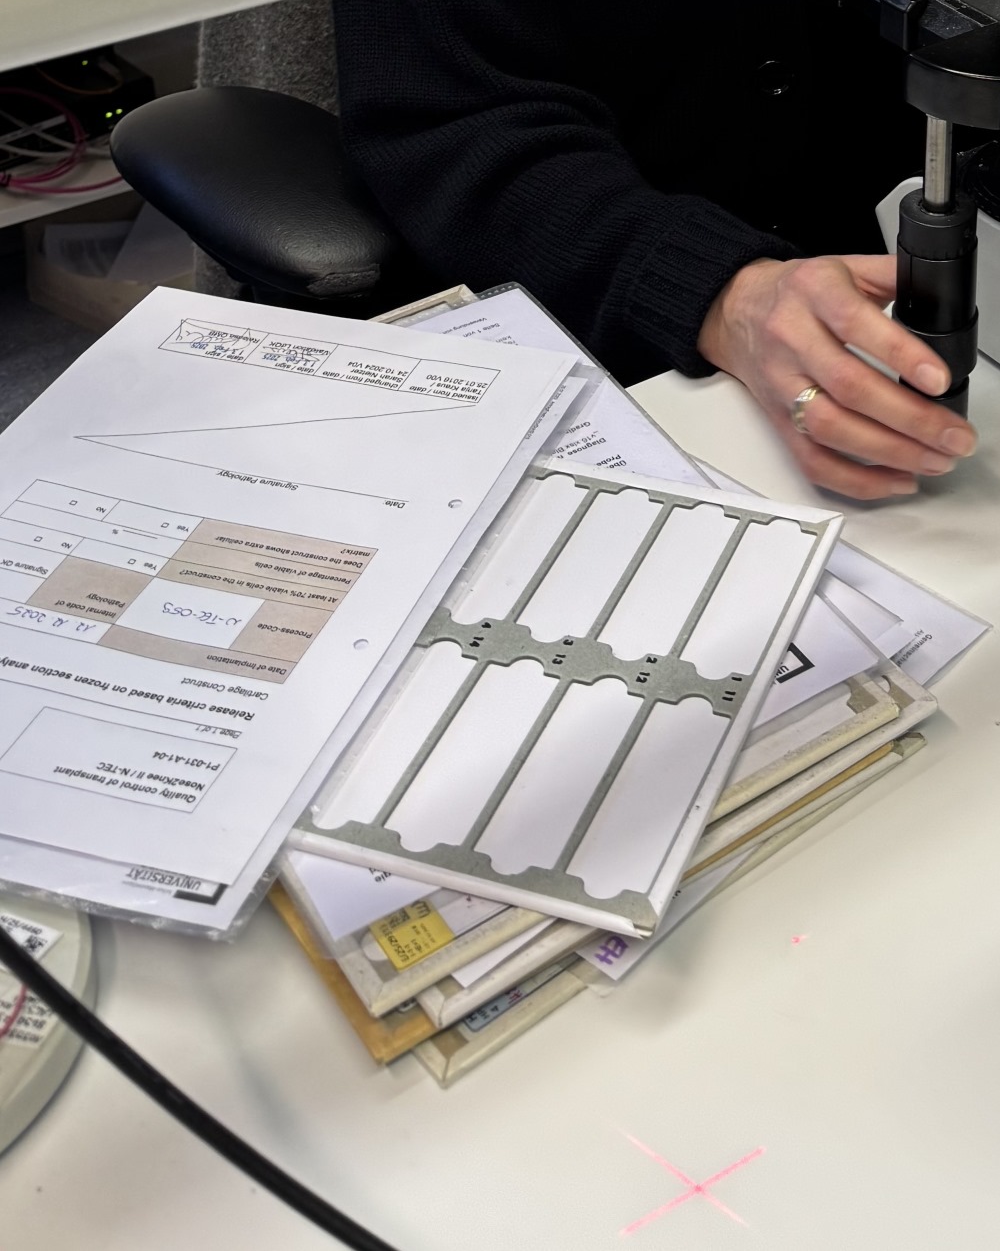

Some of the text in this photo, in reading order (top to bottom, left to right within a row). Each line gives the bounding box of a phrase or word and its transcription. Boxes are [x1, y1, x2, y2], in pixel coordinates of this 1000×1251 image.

[297, 365, 314, 373] date
[345, 375, 363, 383] from
[350, 368, 404, 383] Sarah Nietzer
[364, 377, 399, 390] changed
[436, 383, 482, 395] Tanja Kraus
[433, 389, 451, 398] from
[451, 392, 479, 401] Issued
[567, 437, 607, 456] Diagnose
[260, 477, 299, 491] Signature
[96, 506, 107, 514] No
[177, 524, 190, 533] Yes
[61, 542, 72, 550] No
[214, 536, 243, 546] cellular
[244, 541, 264, 549] extra
[266, 545, 290, 554] shows
[340, 549, 370, 557] matrix?
[291, 550, 328, 561] construct
[15, 562, 49, 576] Signature
[144, 562, 158, 571] Yes
[343, 559, 363, 569] Does
[179, 569, 221, 583] construct?
[254, 561, 351, 584] Percentage of viable cells
[246, 581, 264, 590] cells
[265, 585, 288, 594] viable
[290, 590, 306, 598] 70%
[309, 593, 326, 601] least
[86, 593, 126, 608] Pathology
[327, 596, 338, 604] At
[55, 599, 117, 619] Internal code of
[257, 623, 313, 639] Process-Code
[469, 636, 484, 648] 14
[206, 654, 287, 676] Date of Implantation
[552, 654, 566, 665] 13
[646, 656, 658, 664] 2
[635, 671, 650, 683] 12
[0, 655, 255, 721] Release criteria based on frozen section analy
[181, 677, 269, 701] Cartilage Construct
[152, 751, 221, 771] P1-031-A1-04
[96, 761, 130, 777] N-TEC
[53, 766, 196, 804] Quality control of transplant
[147, 773, 206, 791] Nose2Knee
[125, 867, 202, 891] UNIVERSITÄT
